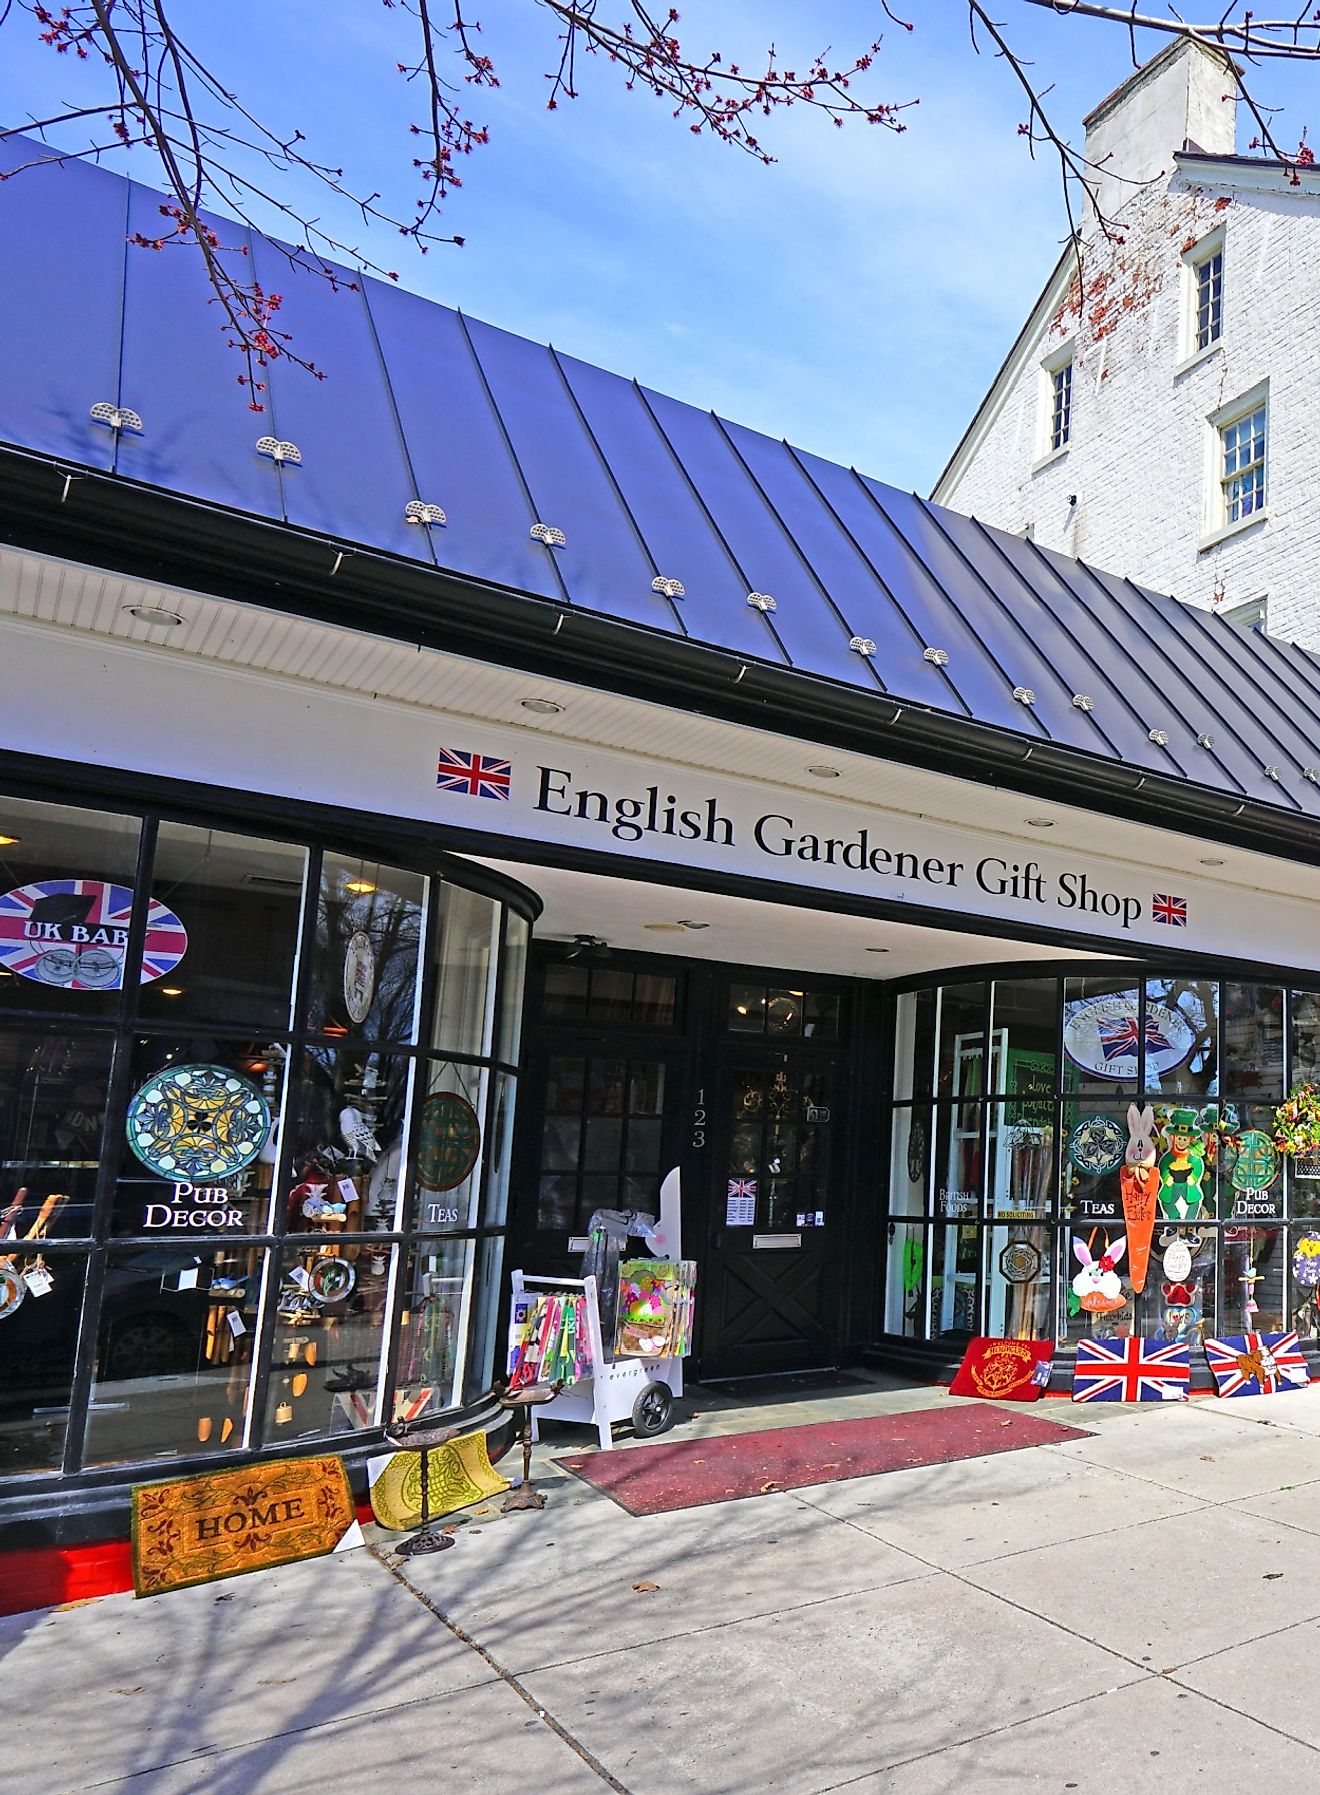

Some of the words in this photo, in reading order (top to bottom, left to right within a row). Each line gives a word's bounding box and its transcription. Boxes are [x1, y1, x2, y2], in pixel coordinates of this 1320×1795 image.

[533, 765, 735, 847] English
[753, 814, 963, 887] Gardener
[976, 857, 1047, 903] Gift
[1057, 872, 1142, 929] Shop
[23, 921, 63, 940] UK
[71, 925, 150, 946] BAB
[1094, 1062, 1123, 1075] GIFT
[609, 1364, 660, 1381] evergreen
[195, 1497, 305, 1541] HOME
